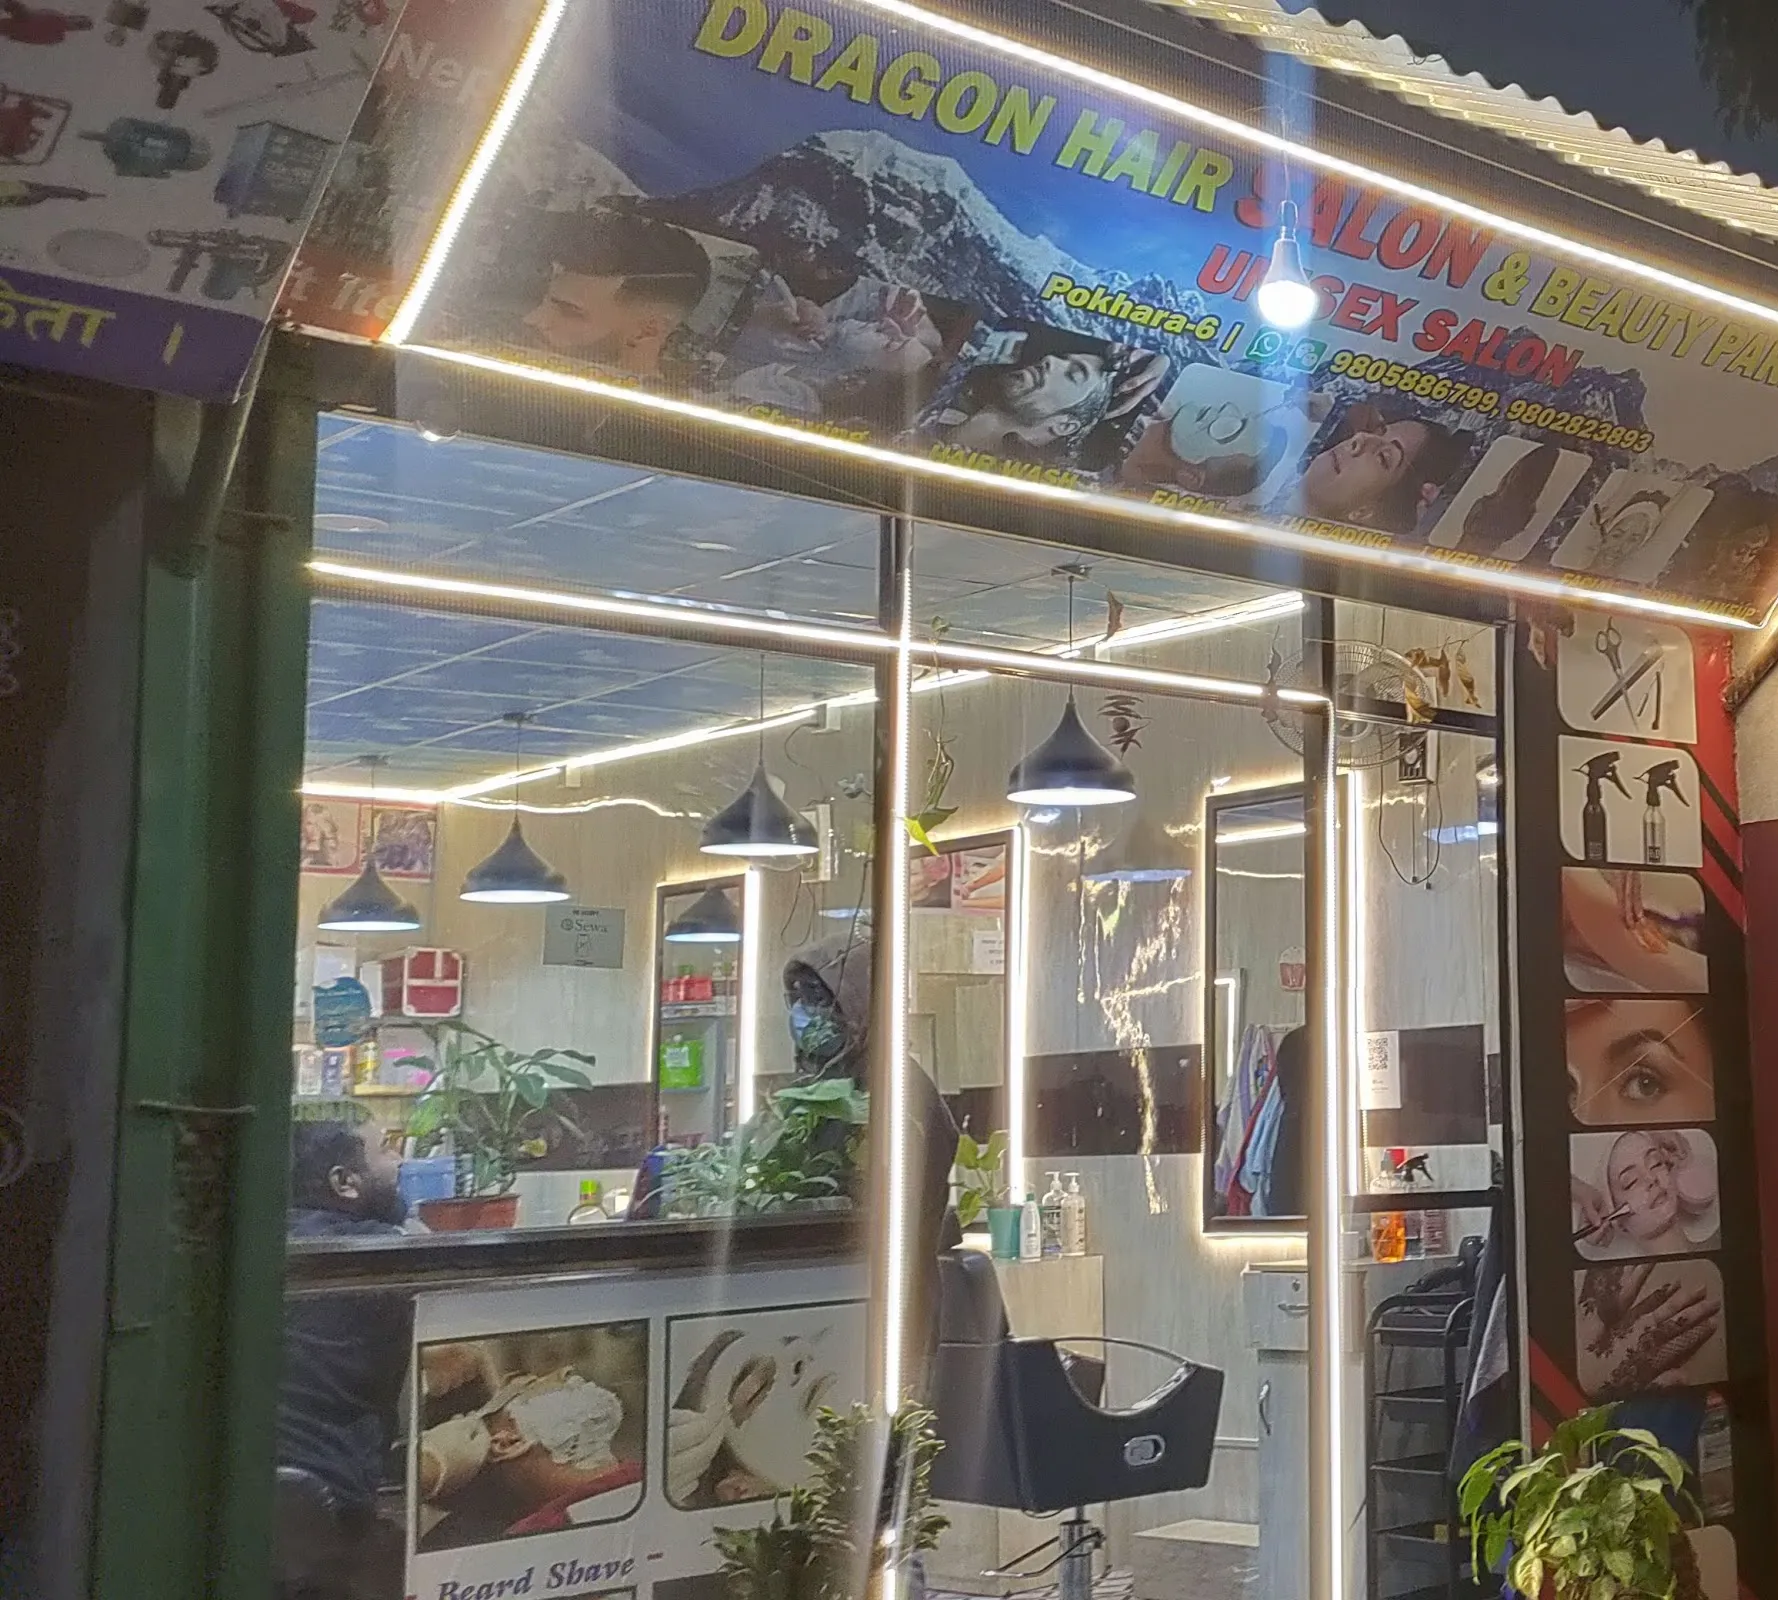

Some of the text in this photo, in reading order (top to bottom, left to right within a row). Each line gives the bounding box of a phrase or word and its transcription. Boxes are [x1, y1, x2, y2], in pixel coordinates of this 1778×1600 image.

[695, 0, 1058, 157] DRAGON
[1056, 108, 1235, 212] HAIR
[1481, 251, 1531, 306] &
[1528, 266, 1717, 359] BEAUTY
[1040, 272, 1222, 343] Pokhara-6
[1329, 349, 1501, 419] 9805886799,
[1506, 399, 1655, 453] 9802823893
[1412, 308, 1585, 389] SALON
[438, 1567, 535, 1600] Beard
[546, 1557, 635, 1589] Shave
